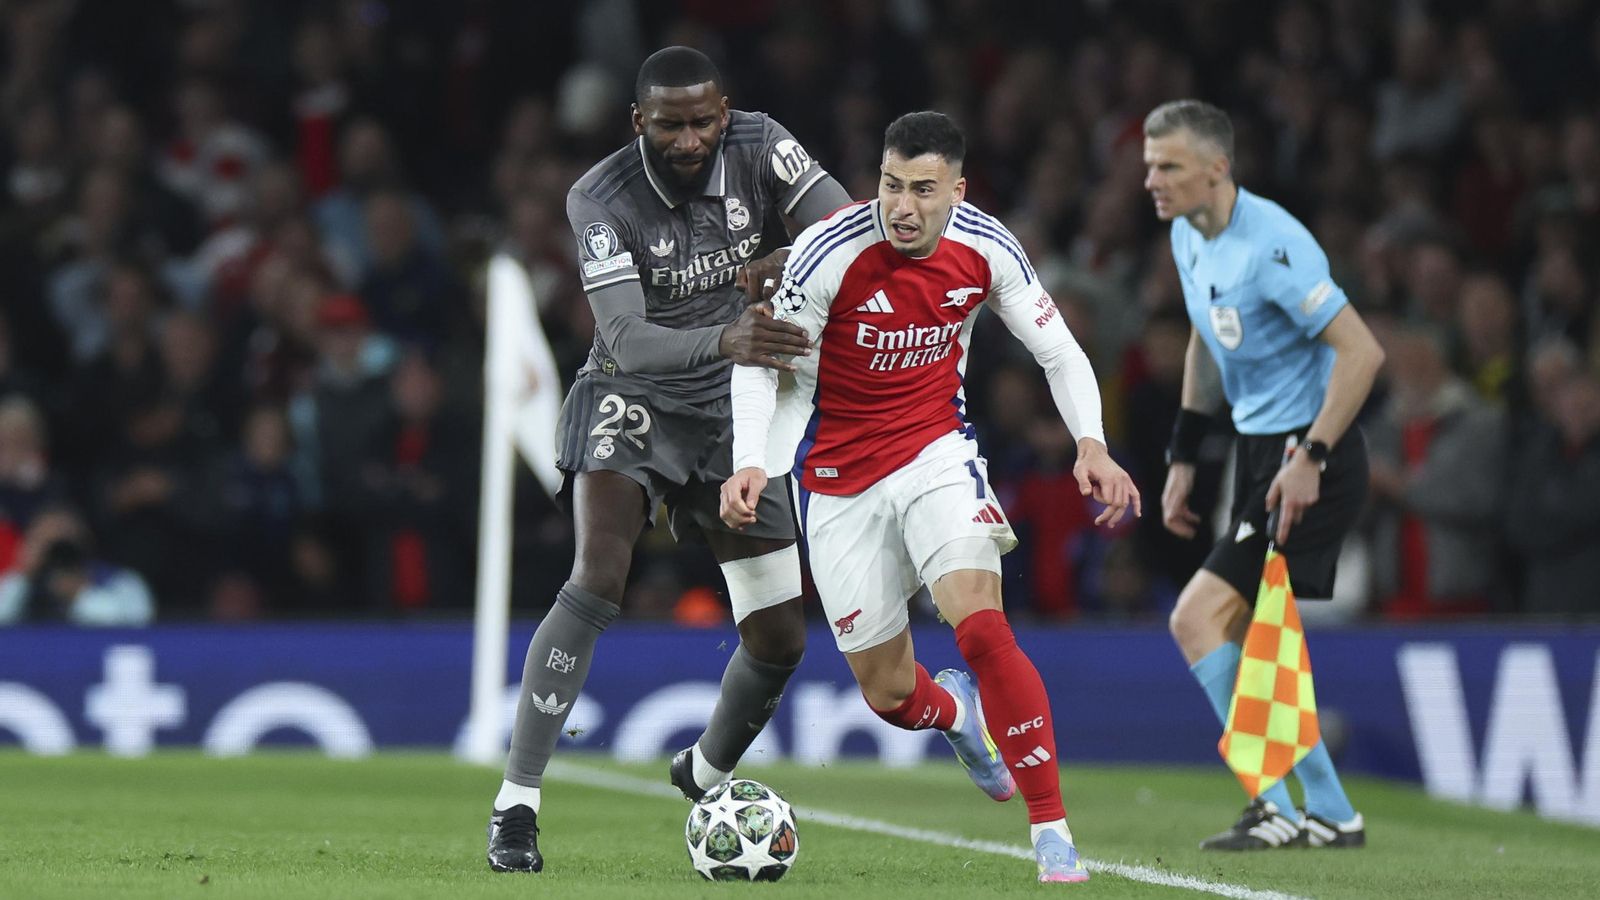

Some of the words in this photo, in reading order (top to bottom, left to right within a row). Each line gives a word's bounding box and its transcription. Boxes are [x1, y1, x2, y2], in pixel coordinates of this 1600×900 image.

[773, 143, 808, 185] hp
[594, 239, 605, 250] 15
[585, 257, 632, 274] FOUNDATION
[651, 233, 762, 287] Emirates
[669, 280, 695, 300] FLY
[700, 259, 751, 291] BETT
[1034, 291, 1050, 309] VIS
[869, 352, 901, 371] FLY
[900, 341, 953, 369] BETTER
[590, 394, 651, 450] 22
[1007, 715, 1044, 737] AFC
